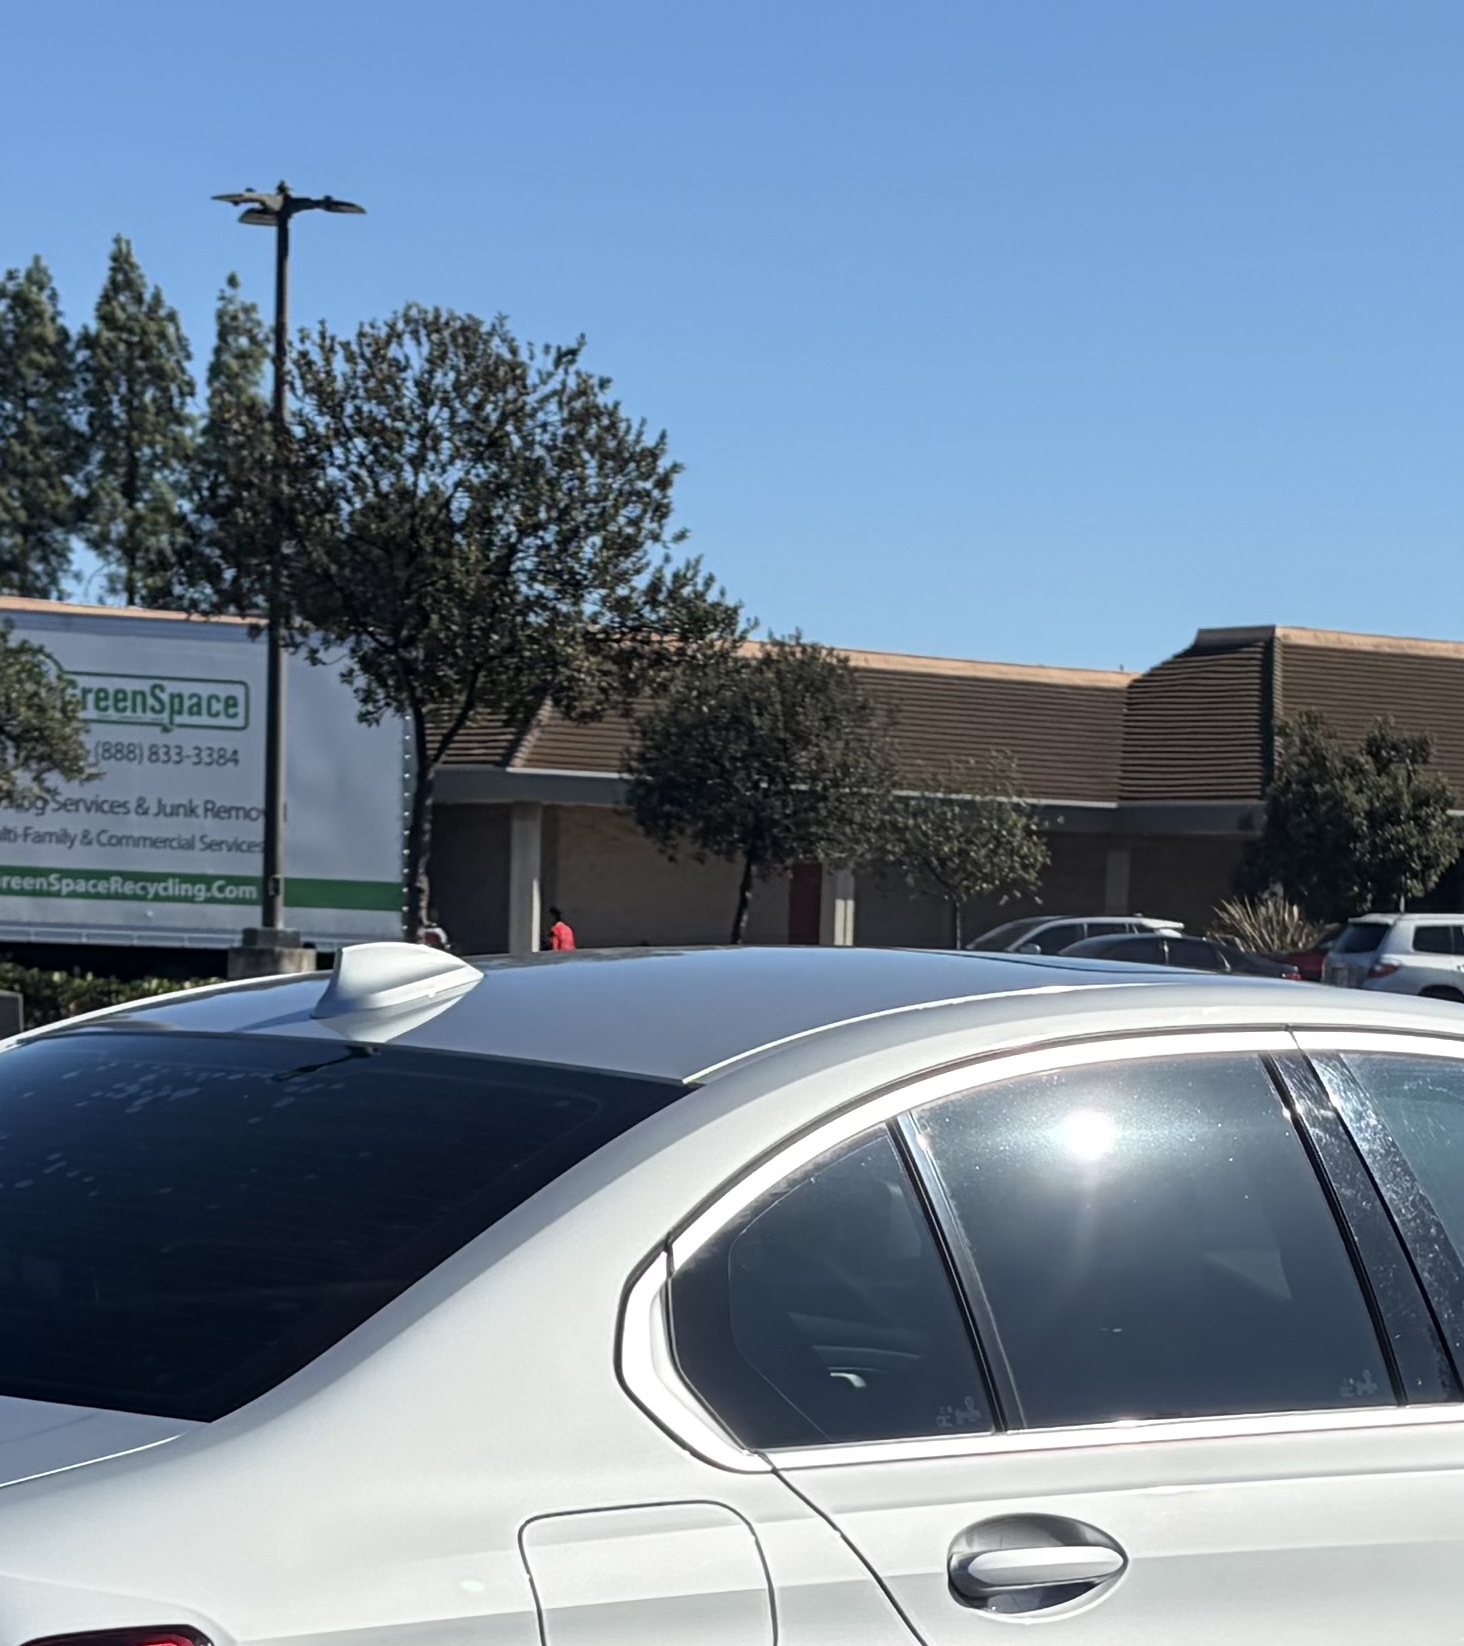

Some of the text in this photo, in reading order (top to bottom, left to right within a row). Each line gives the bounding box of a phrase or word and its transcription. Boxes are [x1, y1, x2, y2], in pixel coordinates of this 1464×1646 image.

[95, 740, 240, 767] (888) 833-3384
[52, 796, 131, 817] Services
[135, 796, 152, 817] &
[153, 798, 201, 819] Junk
[80, 828, 94, 846] &
[96, 829, 195, 850] Commercial
